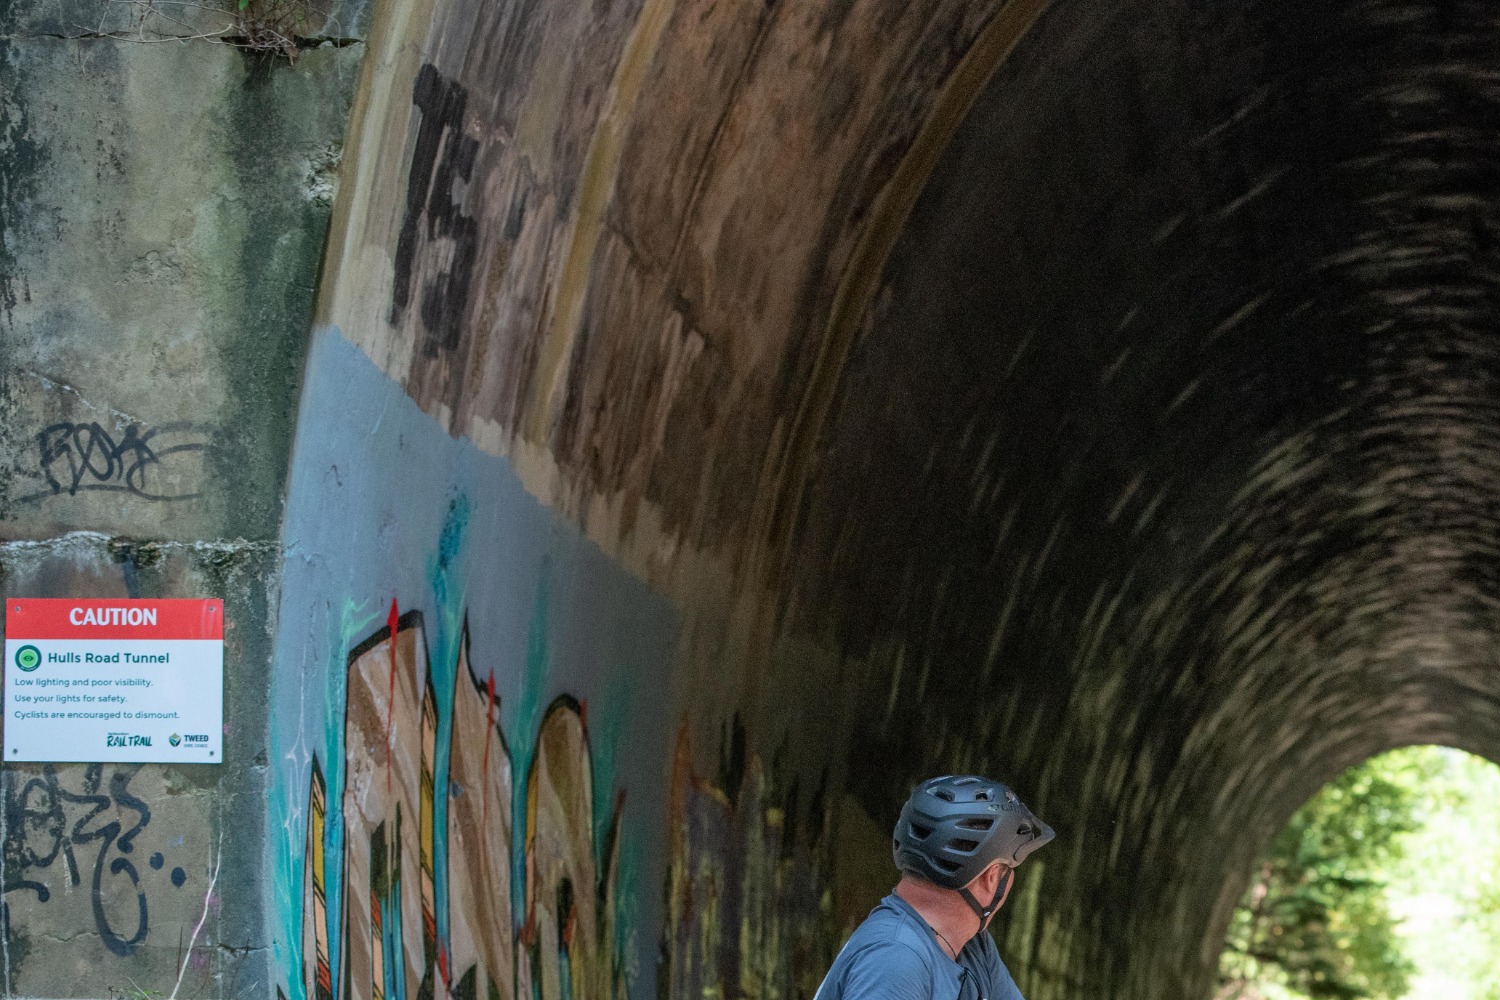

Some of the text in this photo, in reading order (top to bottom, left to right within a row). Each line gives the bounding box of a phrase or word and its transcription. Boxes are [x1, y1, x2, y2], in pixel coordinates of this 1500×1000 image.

[69, 607, 157, 626] CAUTION
[48, 652, 170, 664] Hulls Road Tunnel
[15, 678, 153, 688] Low lighting and poor visibility.
[33, 696, 53, 704] your
[56, 694, 80, 704] lights
[83, 694, 96, 702] for
[98, 694, 127, 704] safety.
[14, 710, 49, 720] Cyclists
[67, 711, 121, 720] encouraged
[123, 711, 132, 719] to
[135, 711, 180, 719] dismount.
[107, 735, 152, 747] RAIL TRAIL
